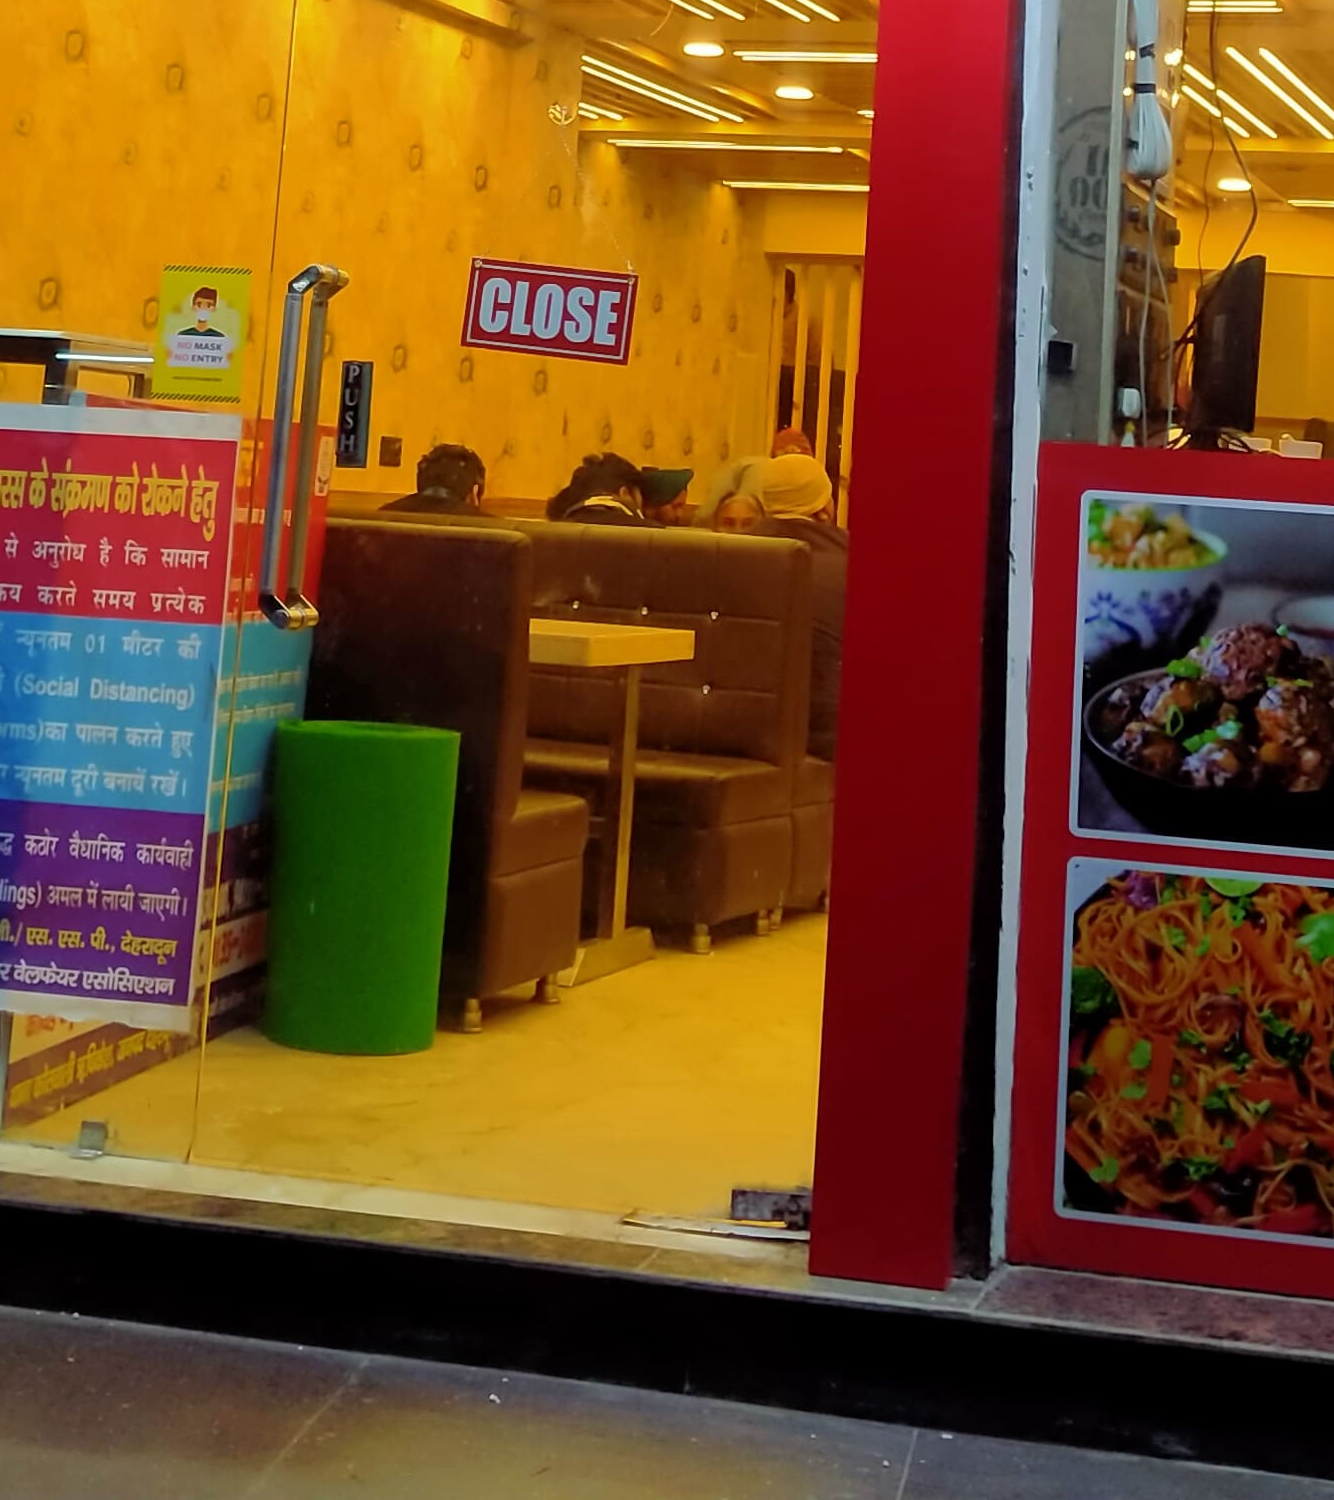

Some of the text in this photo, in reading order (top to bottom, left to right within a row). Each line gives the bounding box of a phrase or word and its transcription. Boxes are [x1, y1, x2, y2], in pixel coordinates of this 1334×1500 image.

[479, 277, 621, 346] CLOSE
[174, 353, 223, 363] NO ENTRY
[177, 341, 222, 350] NO MASK
[340, 365, 362, 453] PUSH
[29, 456, 49, 509] के
[50, 458, 113, 518] संक्रमण
[114, 460, 140, 515] को
[141, 462, 189, 517] रोकने
[190, 464, 219, 542] हेतु
[4, 531, 19, 557] से
[32, 535, 87, 568] अनुरोध
[99, 536, 113, 567] है
[124, 539, 148, 565] कि
[160, 548, 210, 569] सामान
[37, 580, 77, 606] करते
[92, 589, 136, 610] समय
[150, 587, 206, 614] प्रत्येक
[15, 629, 72, 657] न्यूनतम
[85, 634, 106, 654] 01
[122, 629, 164, 656] मीटर
[177, 632, 202, 659] की
[14, 673, 80, 698] (Social
[90, 678, 195, 711] Distancing)
[75, 722, 119, 745] पालन
[124, 721, 163, 749] करते
[170, 730, 194, 758] हुए
[13, 765, 67, 793] न्यूनतम
[71, 763, 99, 797] दूरी
[102, 767, 147, 793] बनायें
[24, 828, 59, 857] कठोर
[69, 830, 126, 863] वैधानिक
[136, 837, 194, 871] कार्यवाही
[48, 885, 83, 908] अमल
[86, 880, 99, 909] में
[101, 884, 135, 912] लायी
[25, 926, 54, 946] एस.
[58, 929, 86, 949] एस.
[120, 930, 178, 965] देहरादून
[13, 958, 81, 987] वेलफेयर
[82, 967, 176, 997] एसोसिएशन
